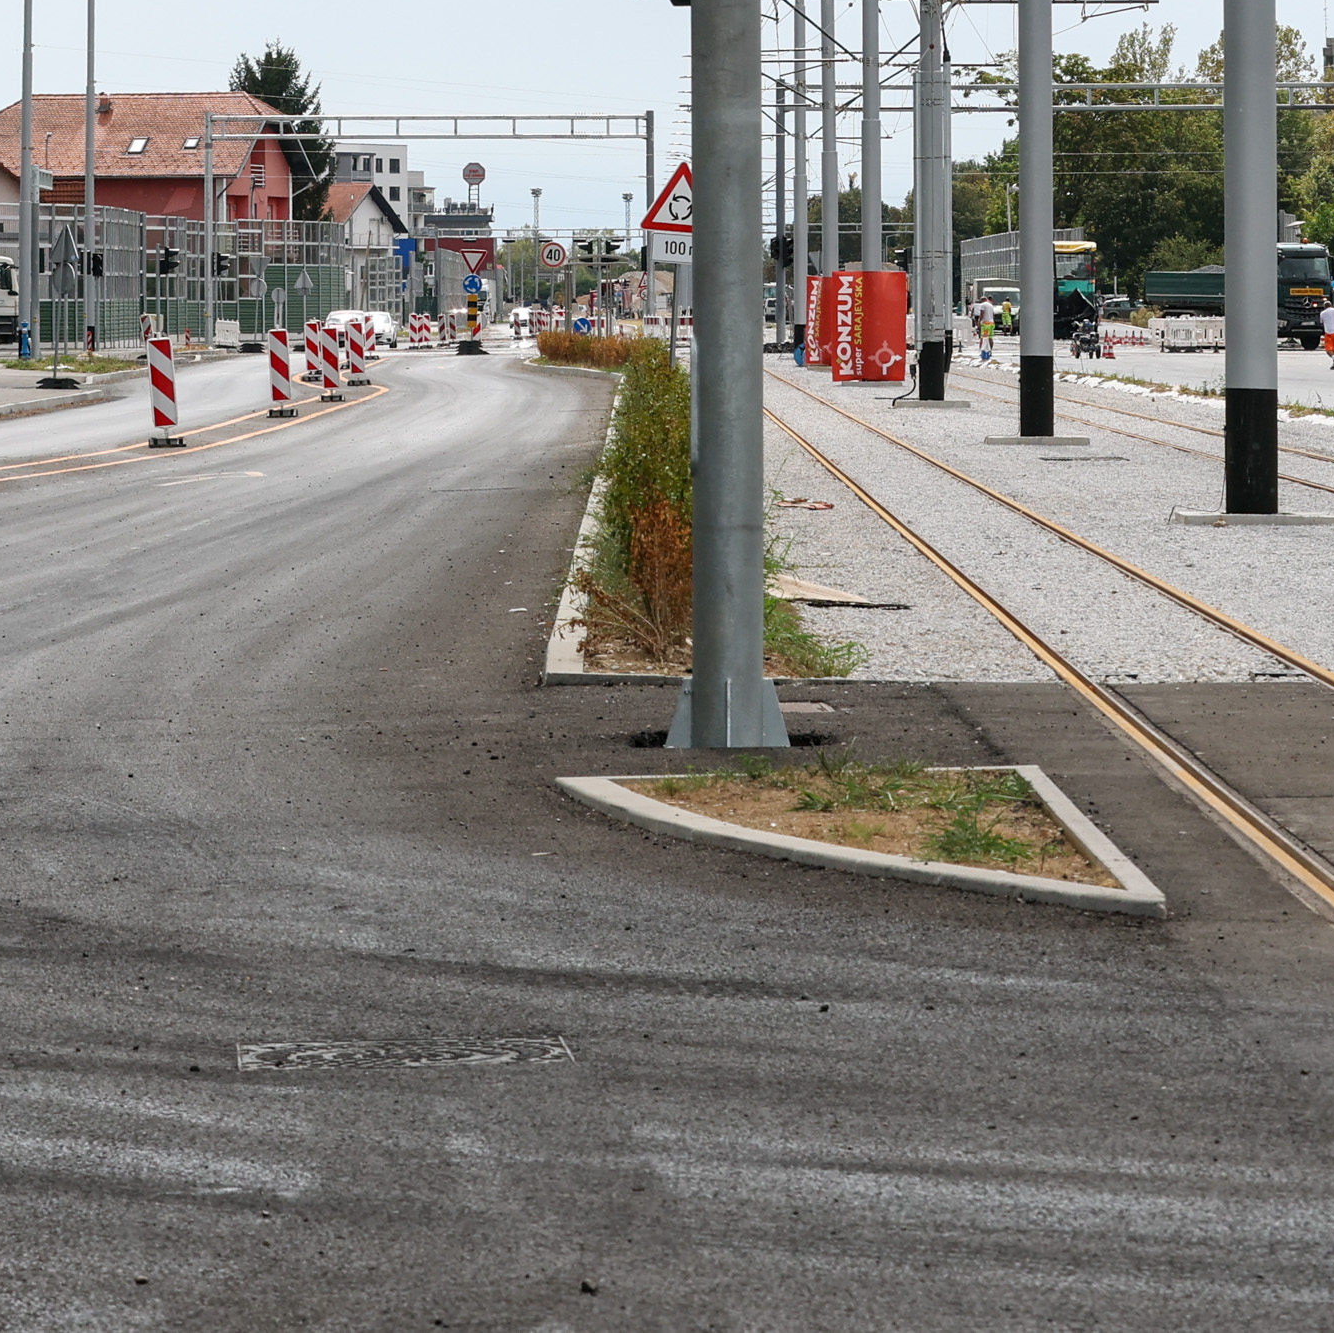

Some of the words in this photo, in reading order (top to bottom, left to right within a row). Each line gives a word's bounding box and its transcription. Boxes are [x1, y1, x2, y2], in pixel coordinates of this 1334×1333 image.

[546, 249, 561, 262] 40
[665, 241, 686, 255] 100
[807, 280, 820, 362] KONZUM
[836, 276, 854, 376] KONZUM
[854, 277, 864, 345] SARAJEVSKA
[854, 347, 864, 375] super
